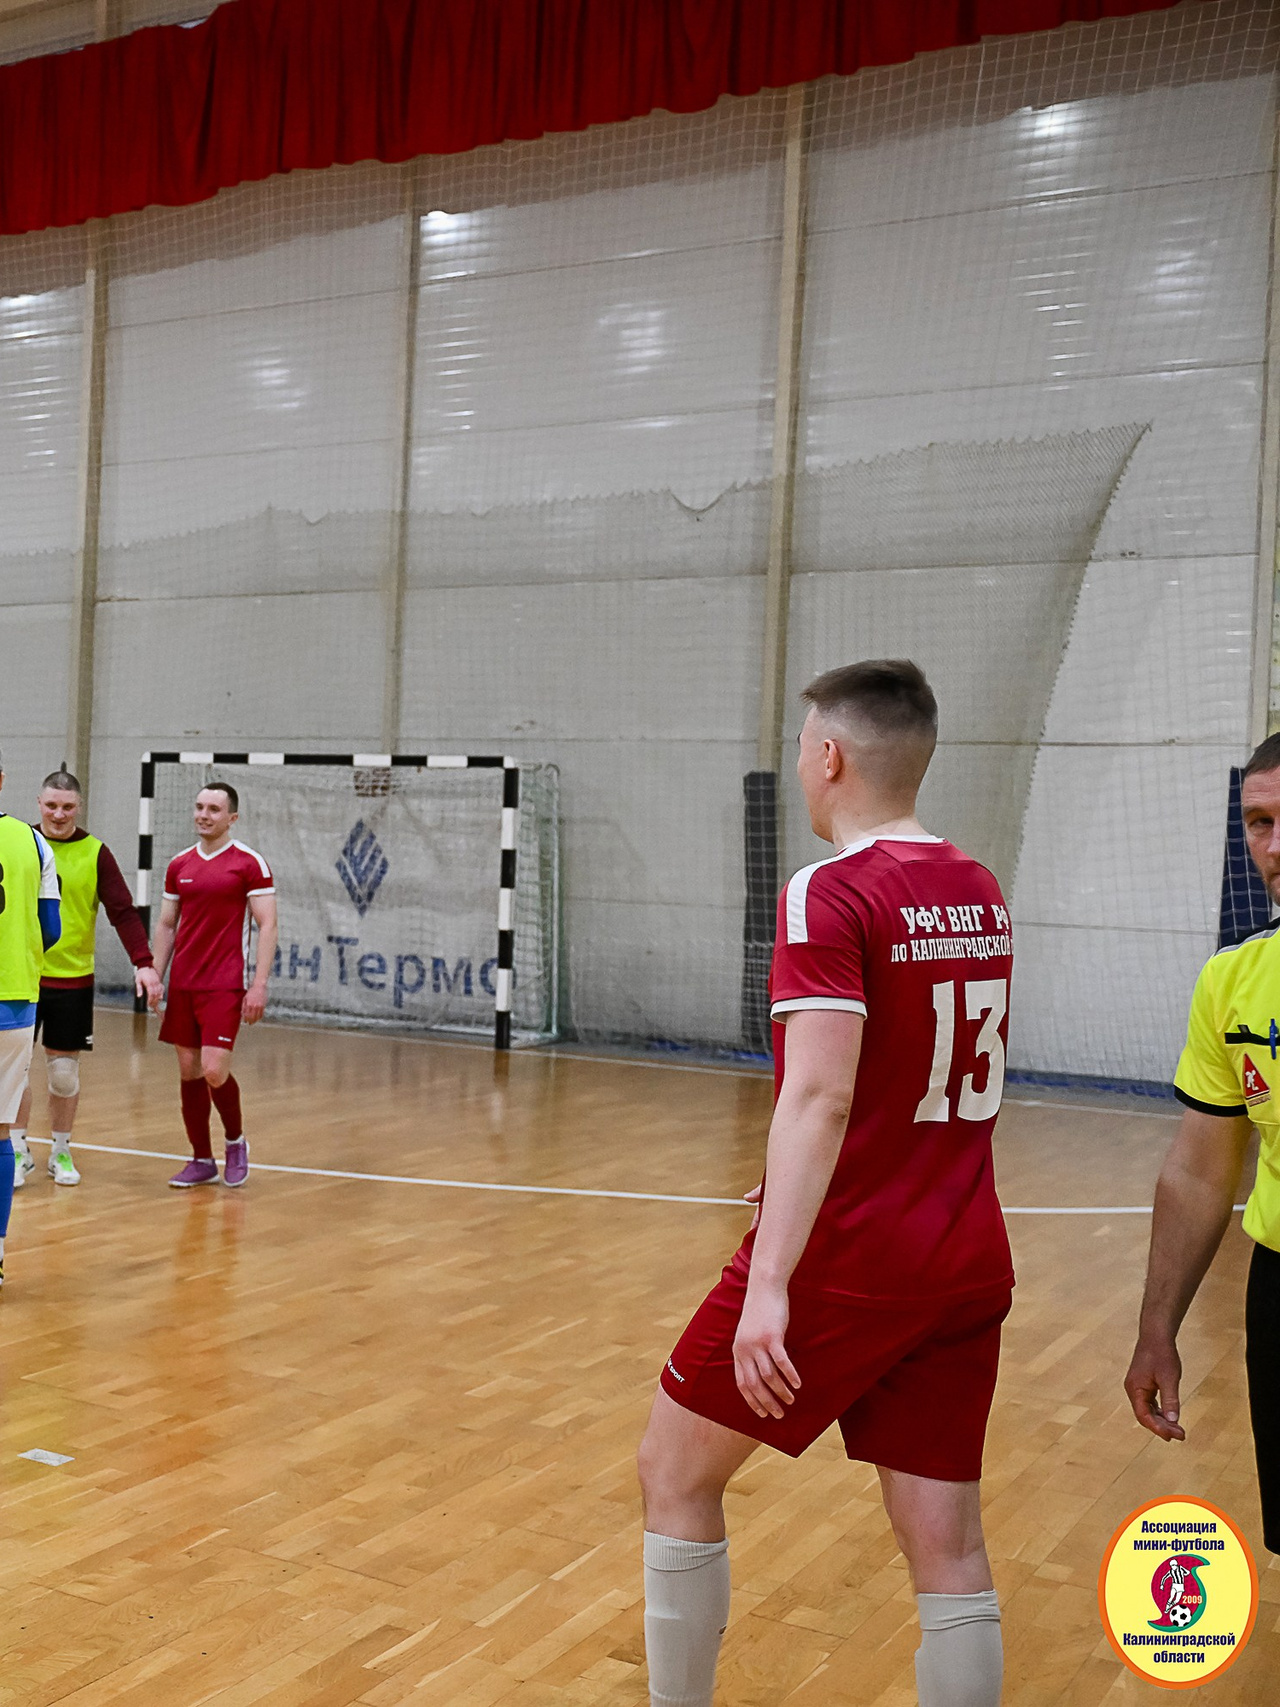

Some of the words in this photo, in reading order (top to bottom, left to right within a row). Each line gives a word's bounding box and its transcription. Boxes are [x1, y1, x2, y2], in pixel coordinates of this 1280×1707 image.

[900, 905, 946, 935] УФС
[945, 904, 985, 933] ВНГ
[990, 904, 1010, 930] РФ
[910, 931, 1011, 961] КАЛИНИНГРАДСКОЙ
[913, 978, 1007, 1123] 13
